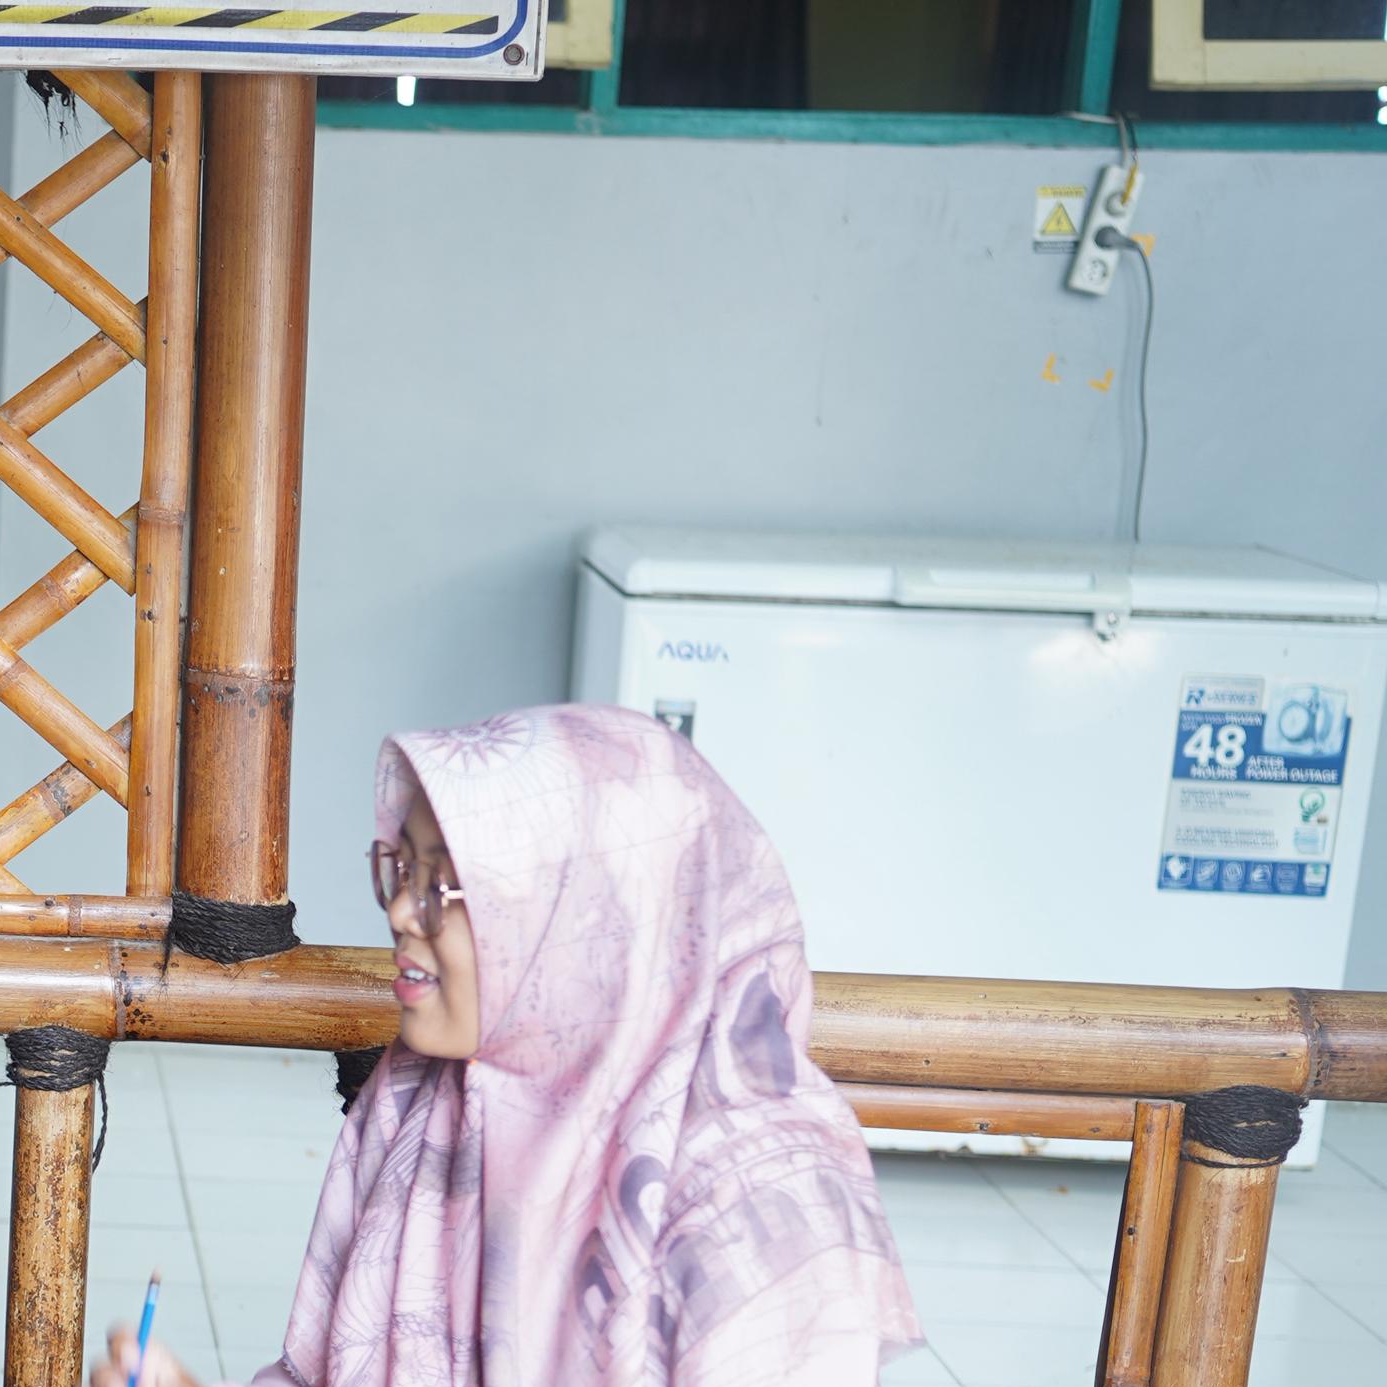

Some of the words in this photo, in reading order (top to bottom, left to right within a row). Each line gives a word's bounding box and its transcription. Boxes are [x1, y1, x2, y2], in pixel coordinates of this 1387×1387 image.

[657, 640, 729, 662] AQUA
[1183, 723, 1247, 767] 48
[1247, 755, 1285, 769] AFTER
[1191, 766, 1237, 780] HOURS
[1245, 767, 1289, 781] POWER
[1290, 768, 1339, 783] OUTAGE
